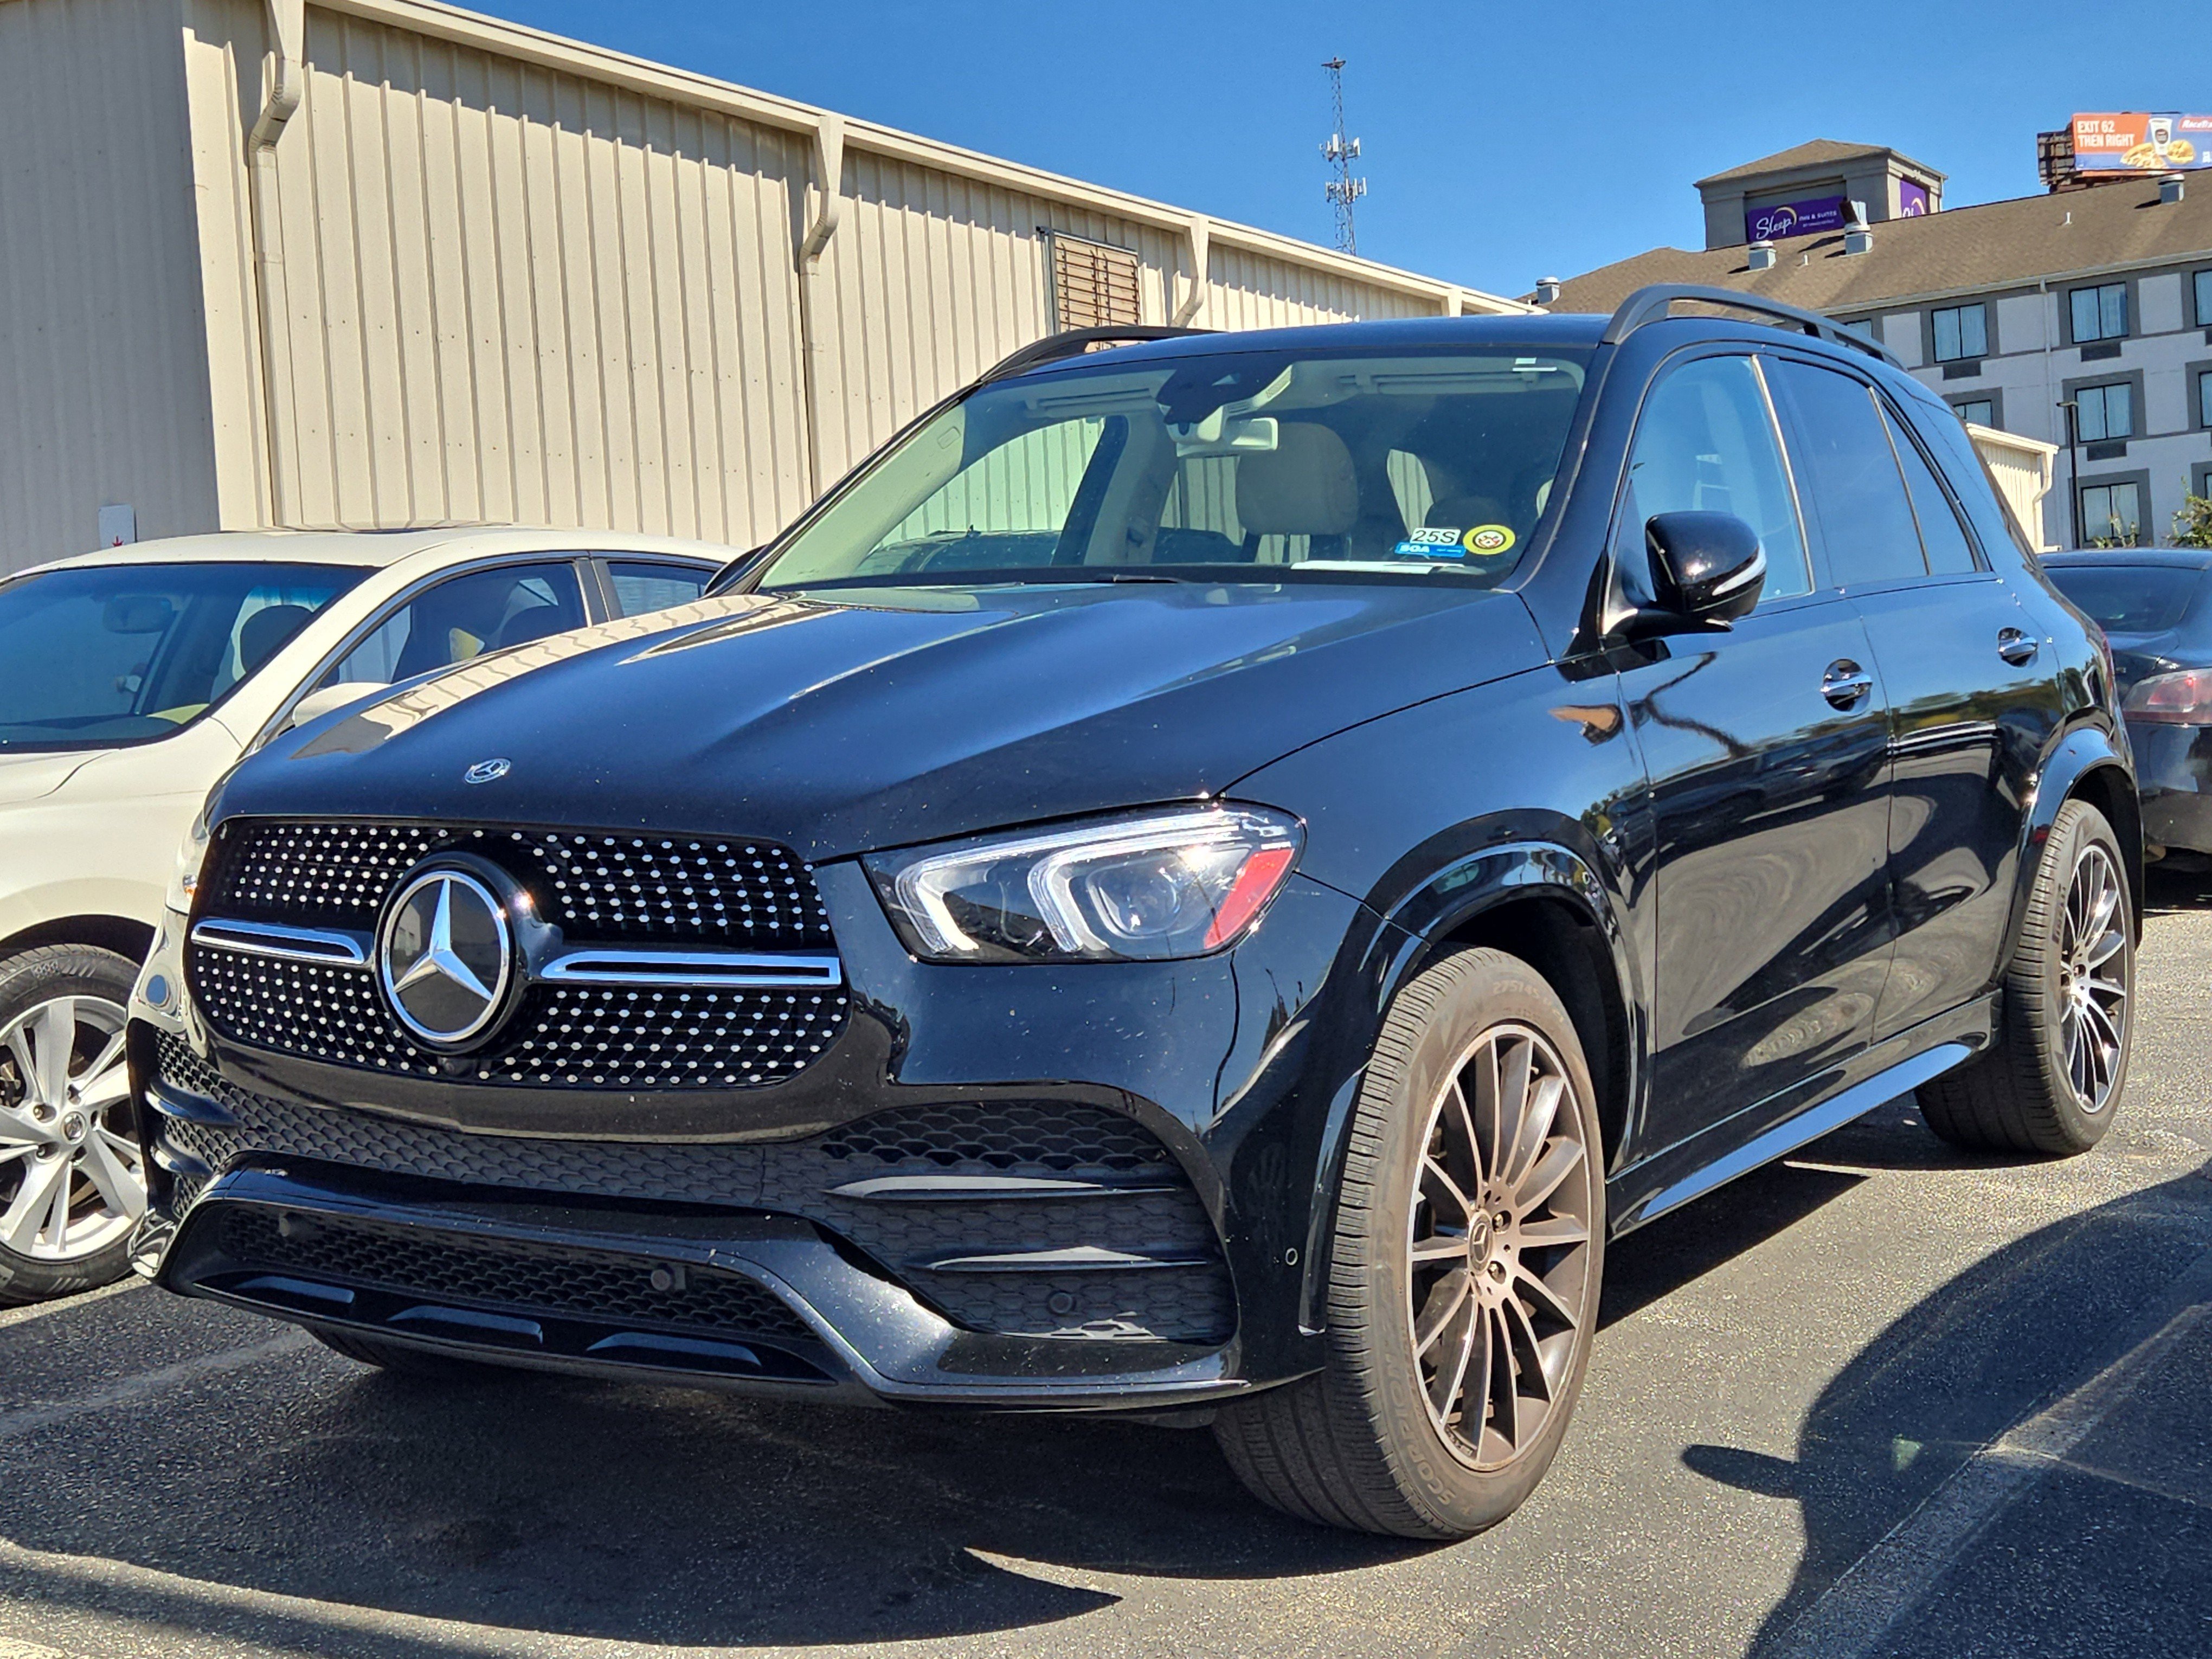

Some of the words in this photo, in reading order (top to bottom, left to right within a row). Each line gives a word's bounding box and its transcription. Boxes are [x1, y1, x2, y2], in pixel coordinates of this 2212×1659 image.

[2076, 120, 2099, 133] EXIT
[2101, 120, 2115, 133] 62
[2078, 134, 2104, 147] THEN
[2105, 134, 2134, 147] RIGHT
[1756, 215, 1793, 240] Sleep
[1412, 530, 1456, 544] 25S
